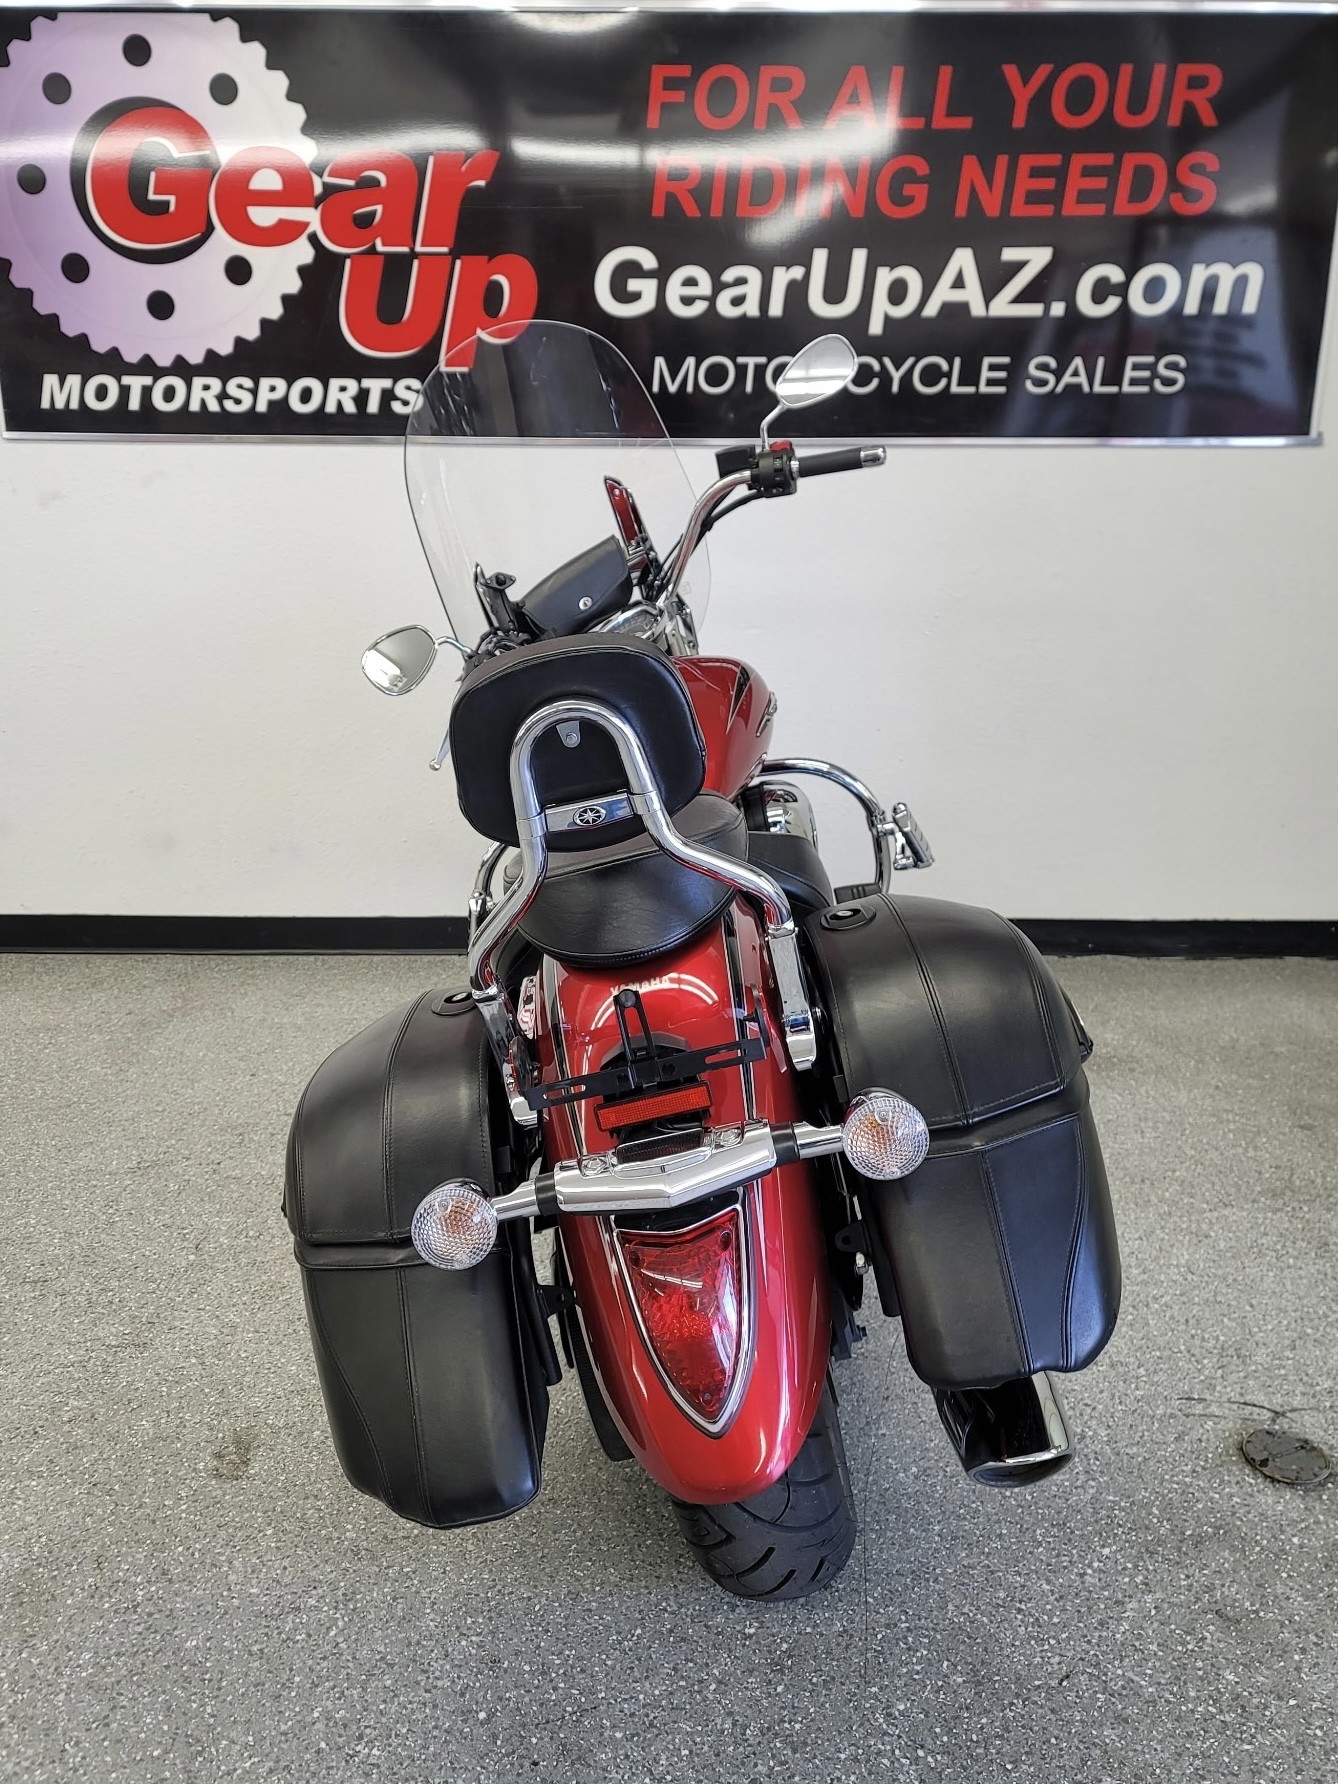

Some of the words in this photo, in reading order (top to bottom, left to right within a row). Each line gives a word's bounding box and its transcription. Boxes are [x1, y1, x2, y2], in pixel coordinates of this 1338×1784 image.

[646, 64, 807, 129] FOR
[824, 64, 974, 129] ALL
[1001, 63, 1223, 129] YOUR
[88, 106, 500, 252] Gear
[651, 154, 929, 219] RIDING
[954, 152, 1221, 218] NEEDS
[338, 252, 539, 372] Up
[593, 245, 1266, 336] GearUpAZ.com
[40, 372, 425, 415] MOTORSPORTS
[651, 354, 1011, 396] MOTCYCLE
[1024, 354, 1188, 396] SALES
